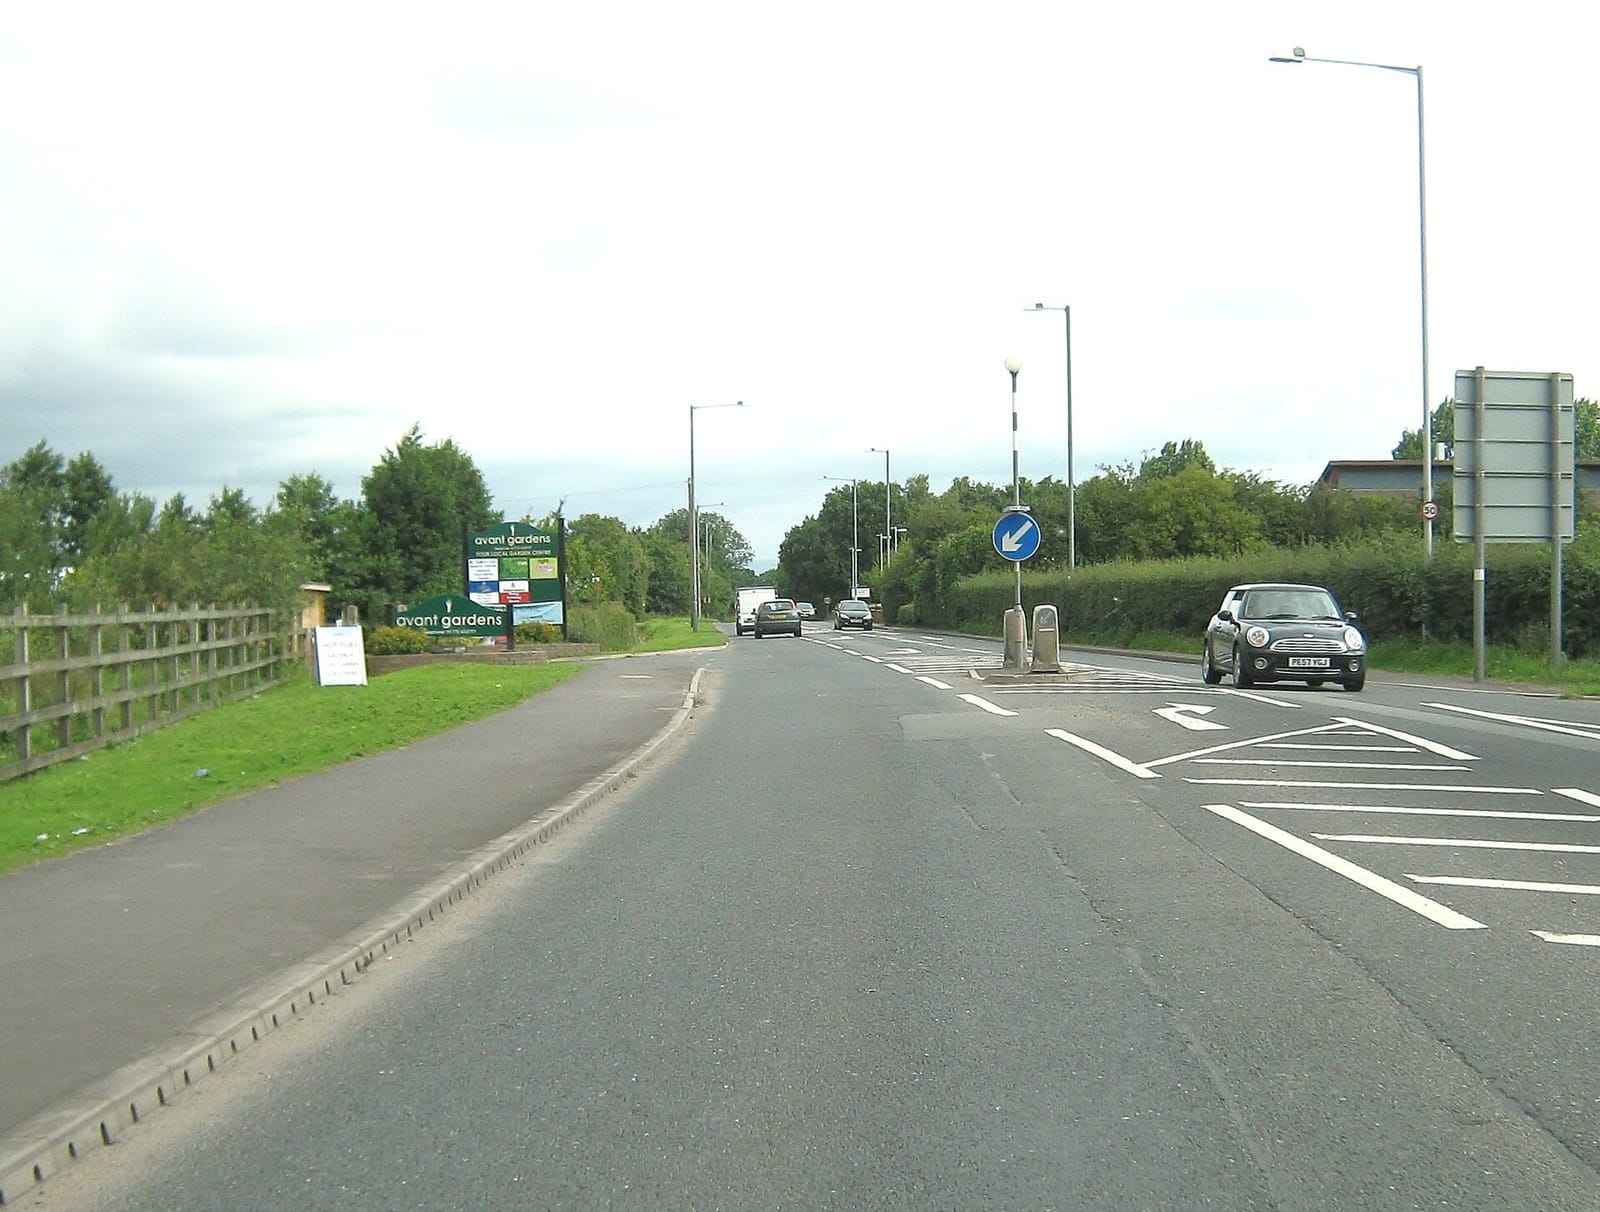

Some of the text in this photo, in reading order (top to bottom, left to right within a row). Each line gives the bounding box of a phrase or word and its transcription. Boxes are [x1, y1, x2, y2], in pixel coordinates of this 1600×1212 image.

[1424, 506, 1436, 515] 50
[474, 534, 551, 546] avant gardens
[396, 614, 502, 629] avant gardens
